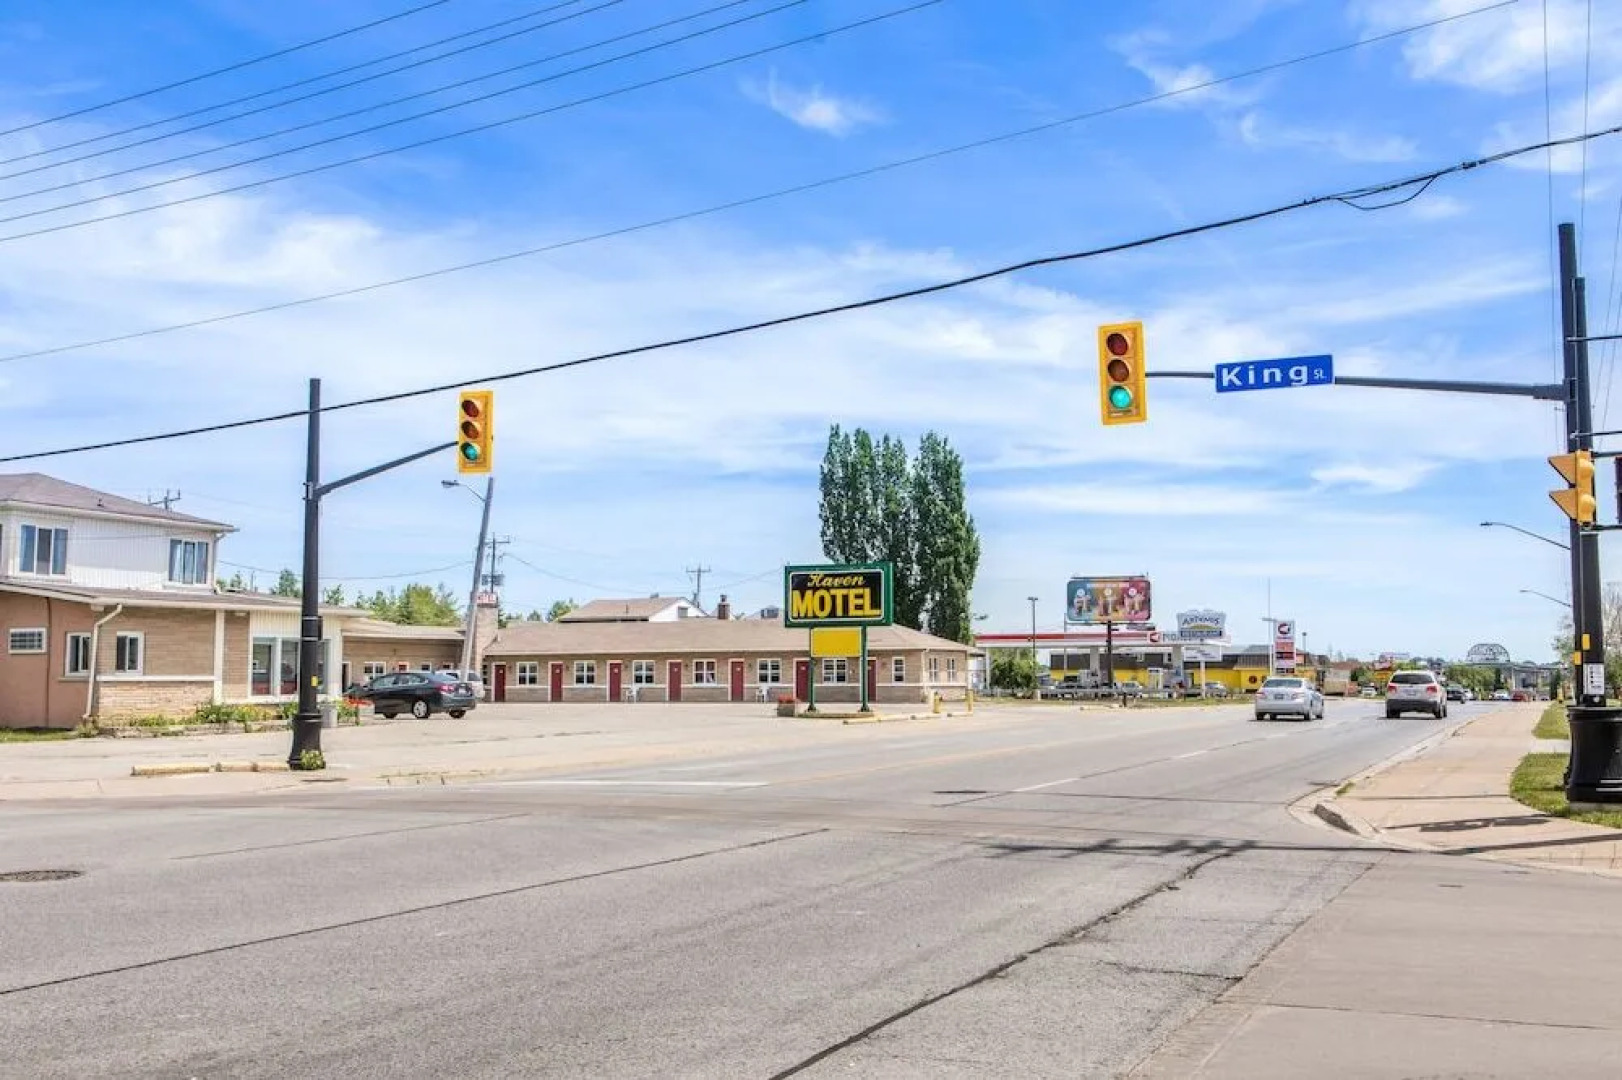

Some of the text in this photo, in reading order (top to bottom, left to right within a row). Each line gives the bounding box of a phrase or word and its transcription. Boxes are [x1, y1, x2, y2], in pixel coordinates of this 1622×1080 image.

[1222, 365, 1308, 386] King
[807, 572, 865, 587] Haven
[792, 588, 882, 617] MOTEL
